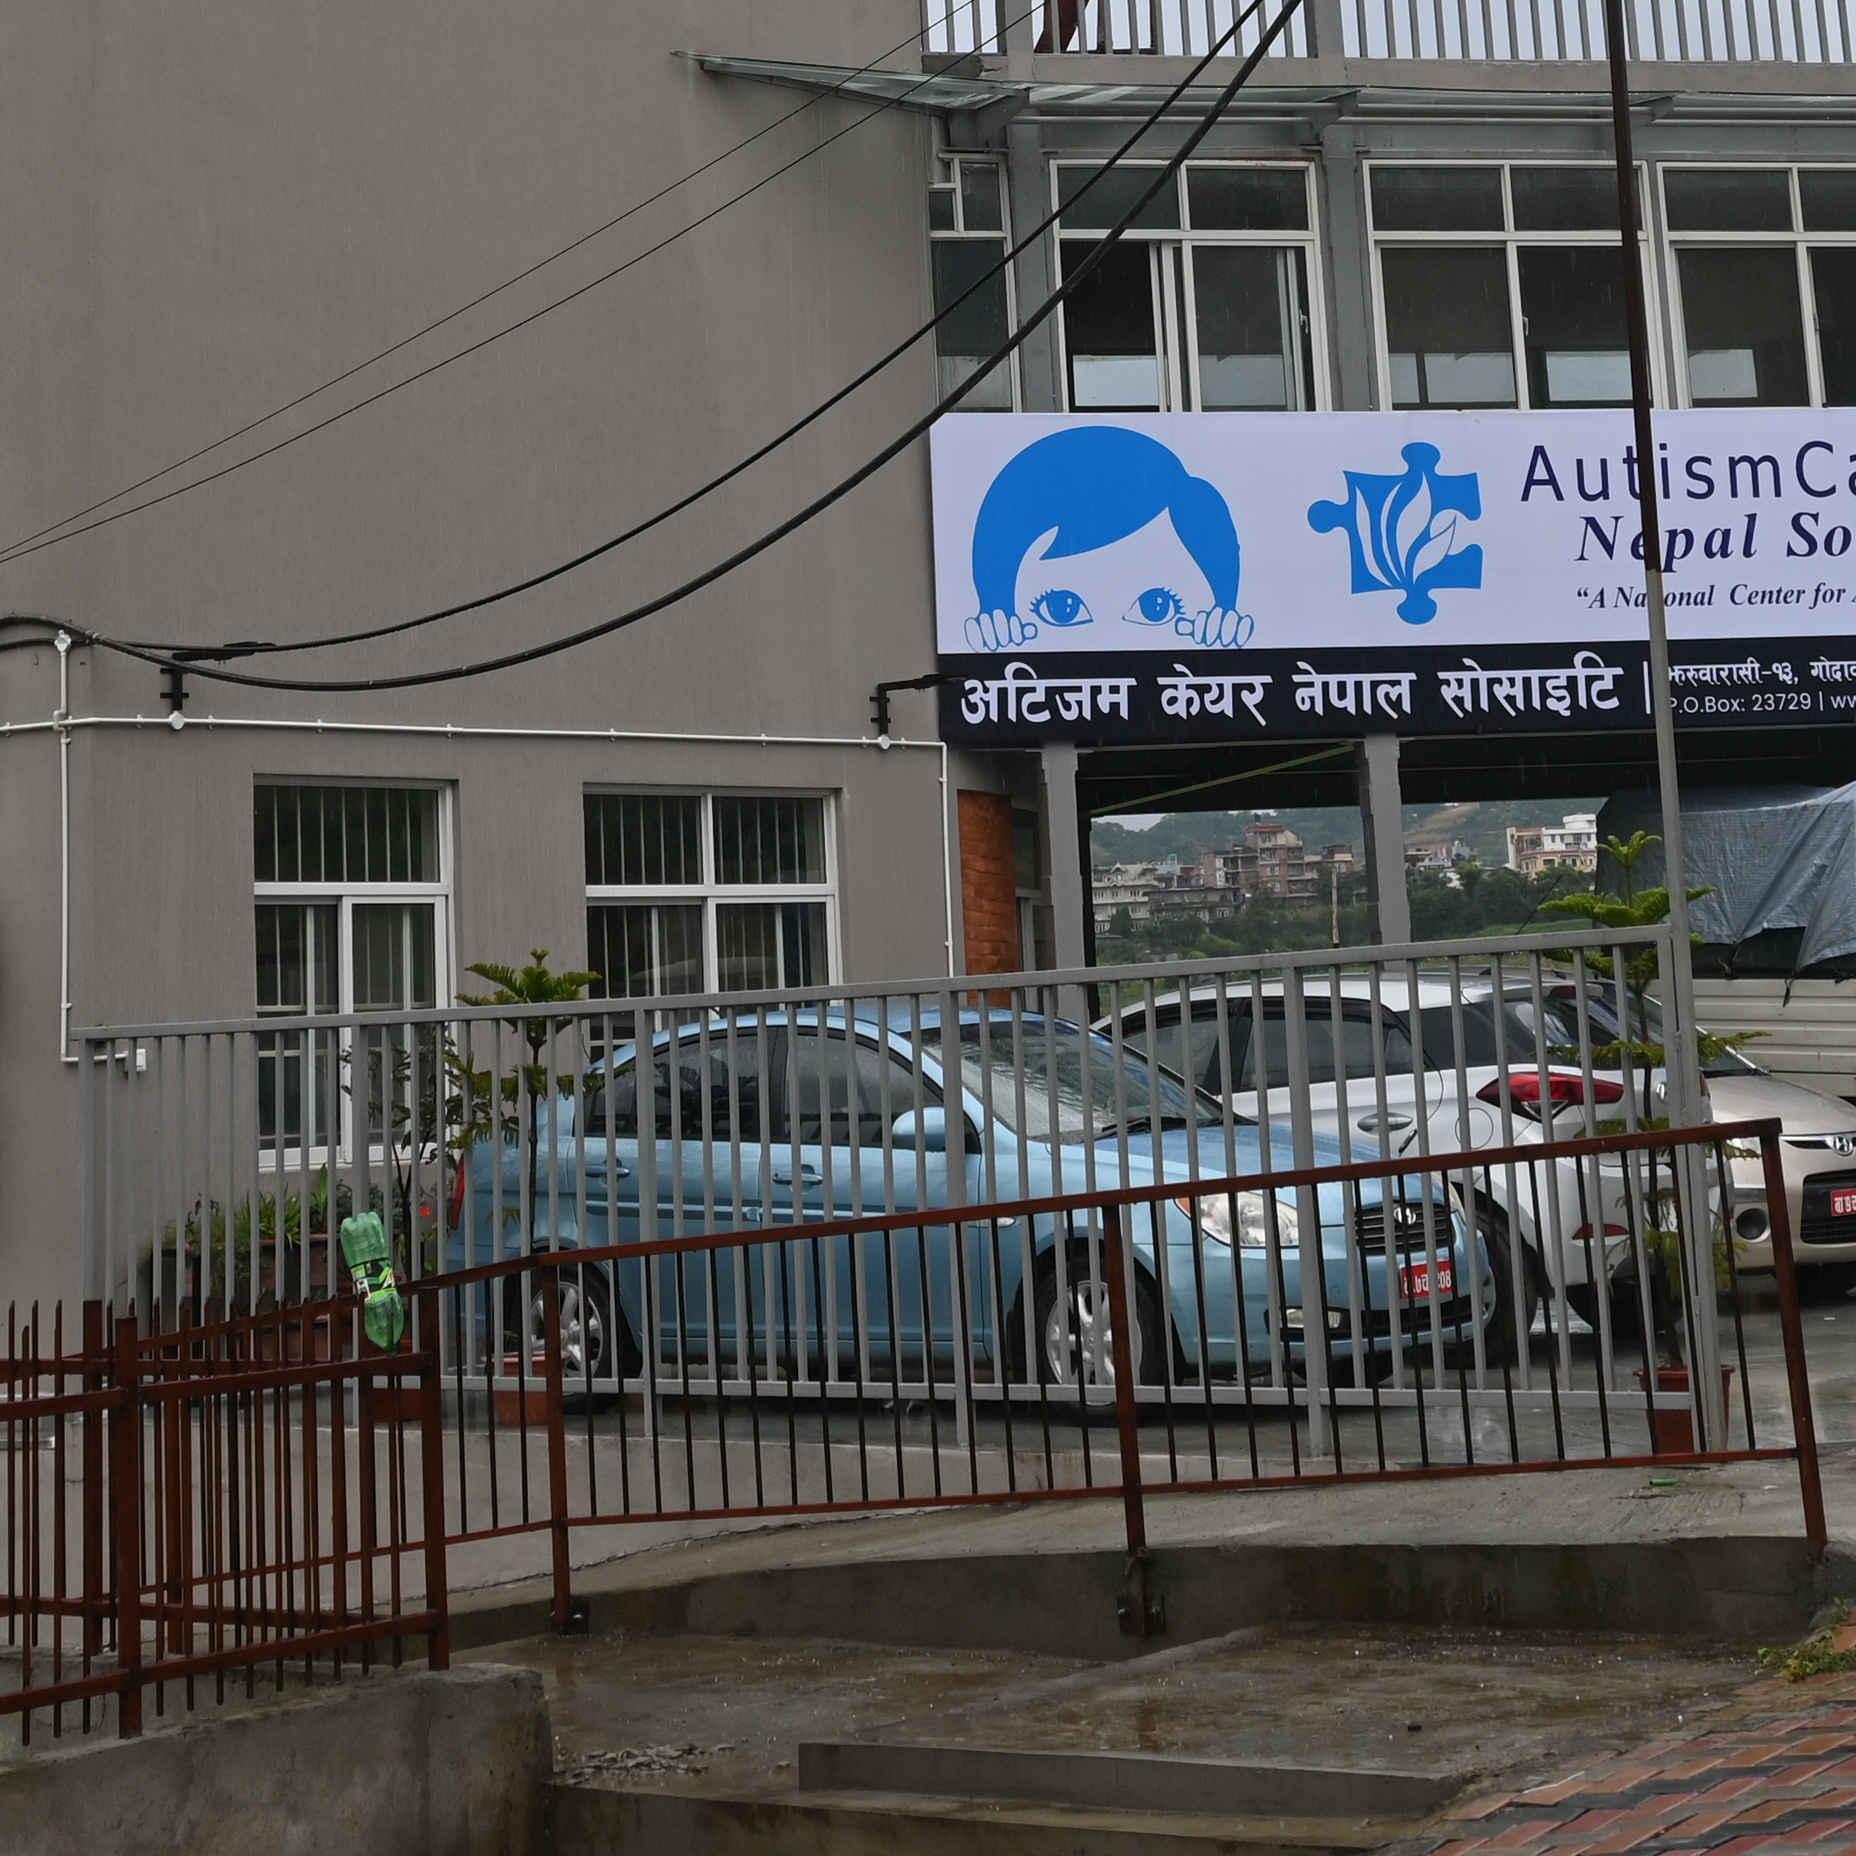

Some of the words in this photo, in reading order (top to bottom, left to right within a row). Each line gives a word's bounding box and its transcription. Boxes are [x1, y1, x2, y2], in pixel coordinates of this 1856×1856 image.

[1574, 512, 1758, 573] Nepal
[1613, 585, 1715, 609] Naonal
[1729, 584, 1806, 606] Center
[1808, 582, 1847, 610] for
[961, 662, 1138, 725] अटिजम
[1156, 663, 1274, 727] केयर
[1292, 661, 1418, 719] नेपाल
[1437, 650, 1625, 719] सोसाइटि
[1751, 692, 1812, 712] 23729
